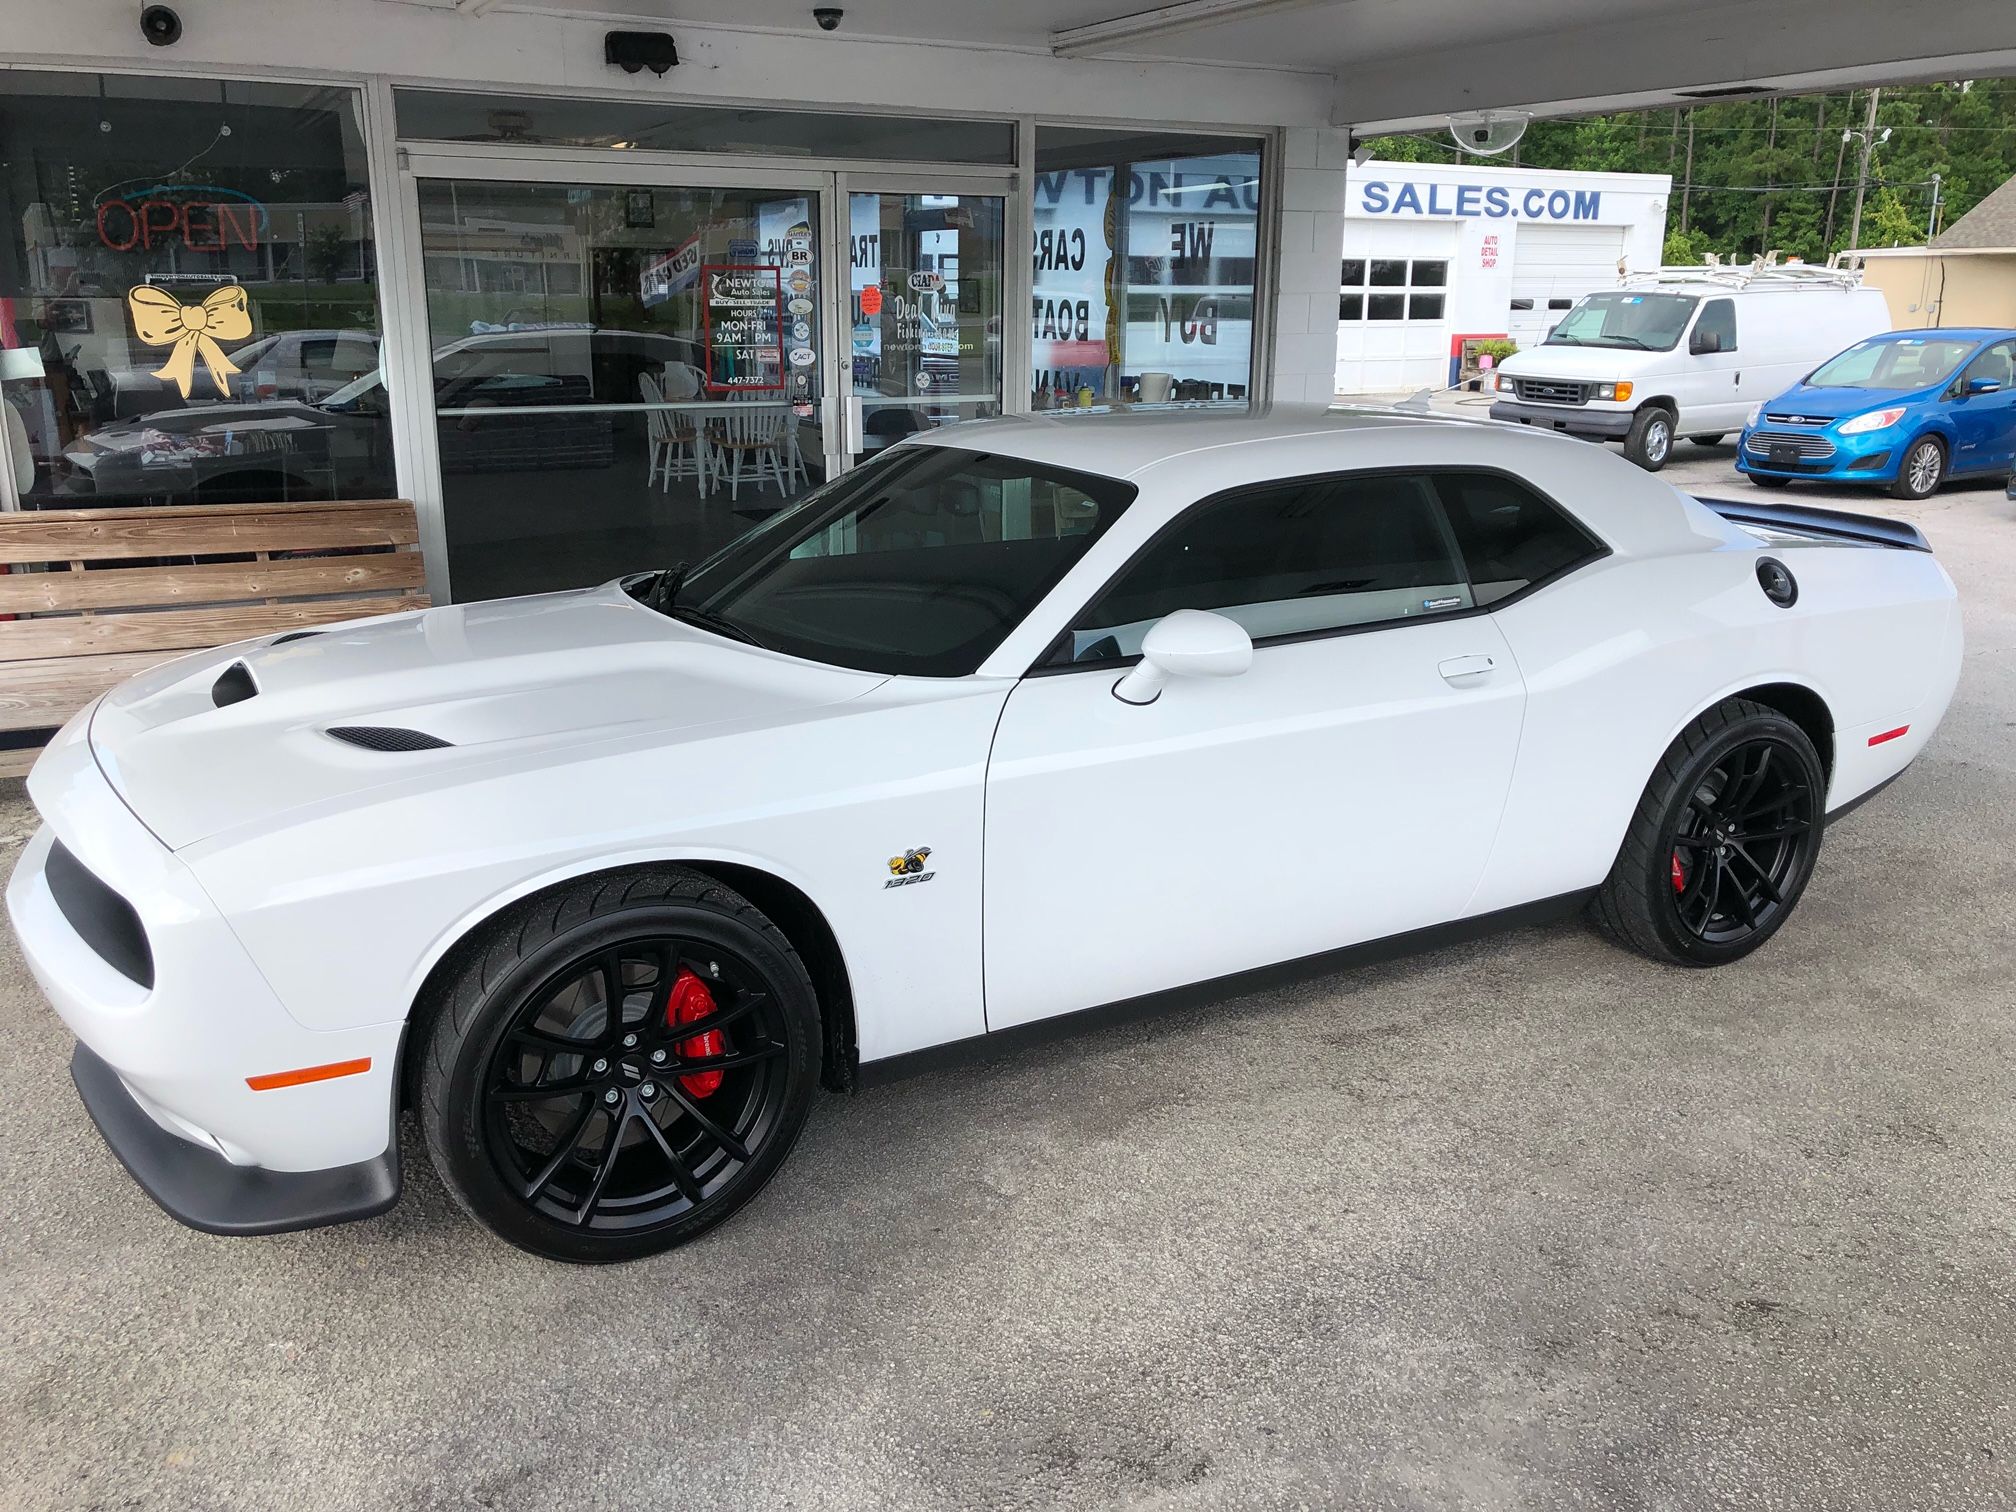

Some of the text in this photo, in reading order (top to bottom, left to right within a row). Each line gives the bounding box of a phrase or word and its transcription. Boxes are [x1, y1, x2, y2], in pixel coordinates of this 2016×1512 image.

[1362, 181, 1600, 220] SALES.COM
[97, 200, 258, 251] OPEN
[1484, 235, 1498, 246] AUTO
[792, 252, 808, 261] BR
[1481, 247, 1498, 257] DETAIL
[1482, 258, 1496, 268] SHOP
[895, 296, 923, 320] Deal
[721, 321, 766, 331] MON-FRI
[755, 333, 771, 342] PM
[736, 350, 754, 360] SAT
[884, 872, 936, 889] 1320
